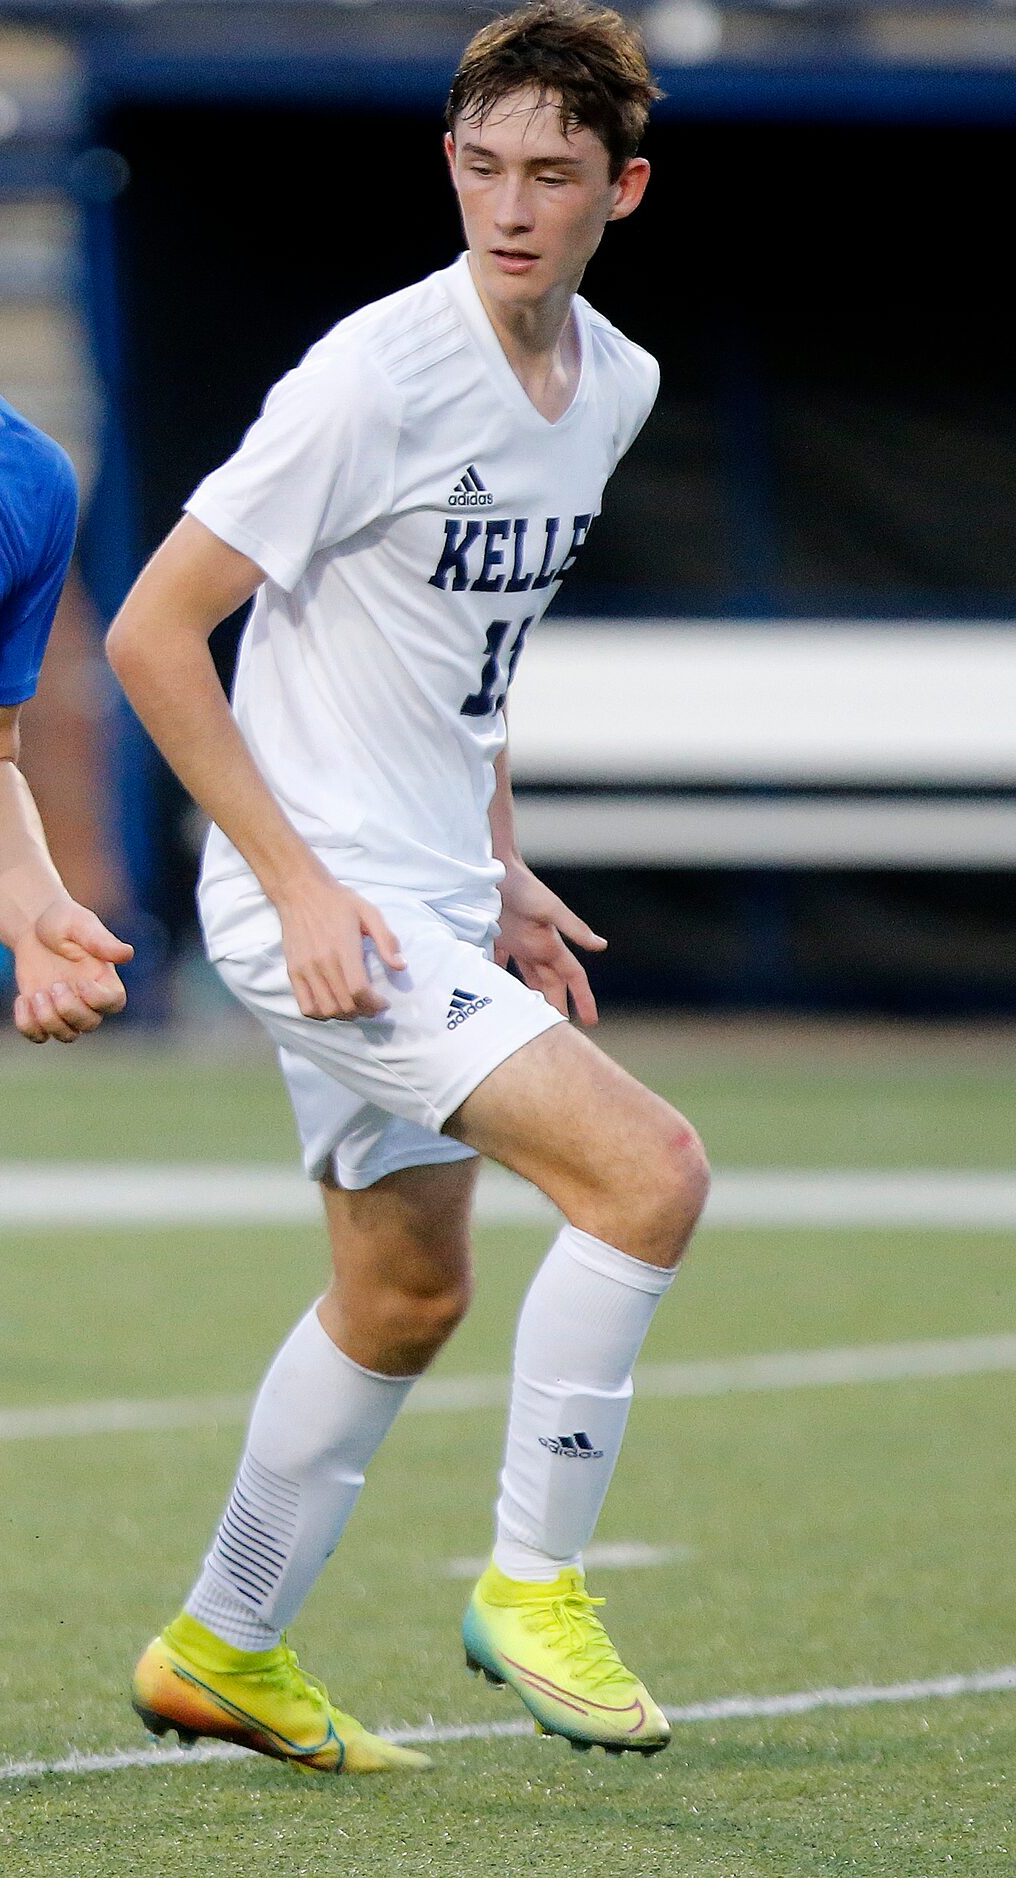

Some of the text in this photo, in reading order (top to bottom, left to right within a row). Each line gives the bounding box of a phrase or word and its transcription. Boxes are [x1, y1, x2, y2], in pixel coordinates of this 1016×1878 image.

[447, 491, 494, 506] adidas
[447, 996, 493, 1030] adidas
[538, 1437, 604, 1459] adidas
